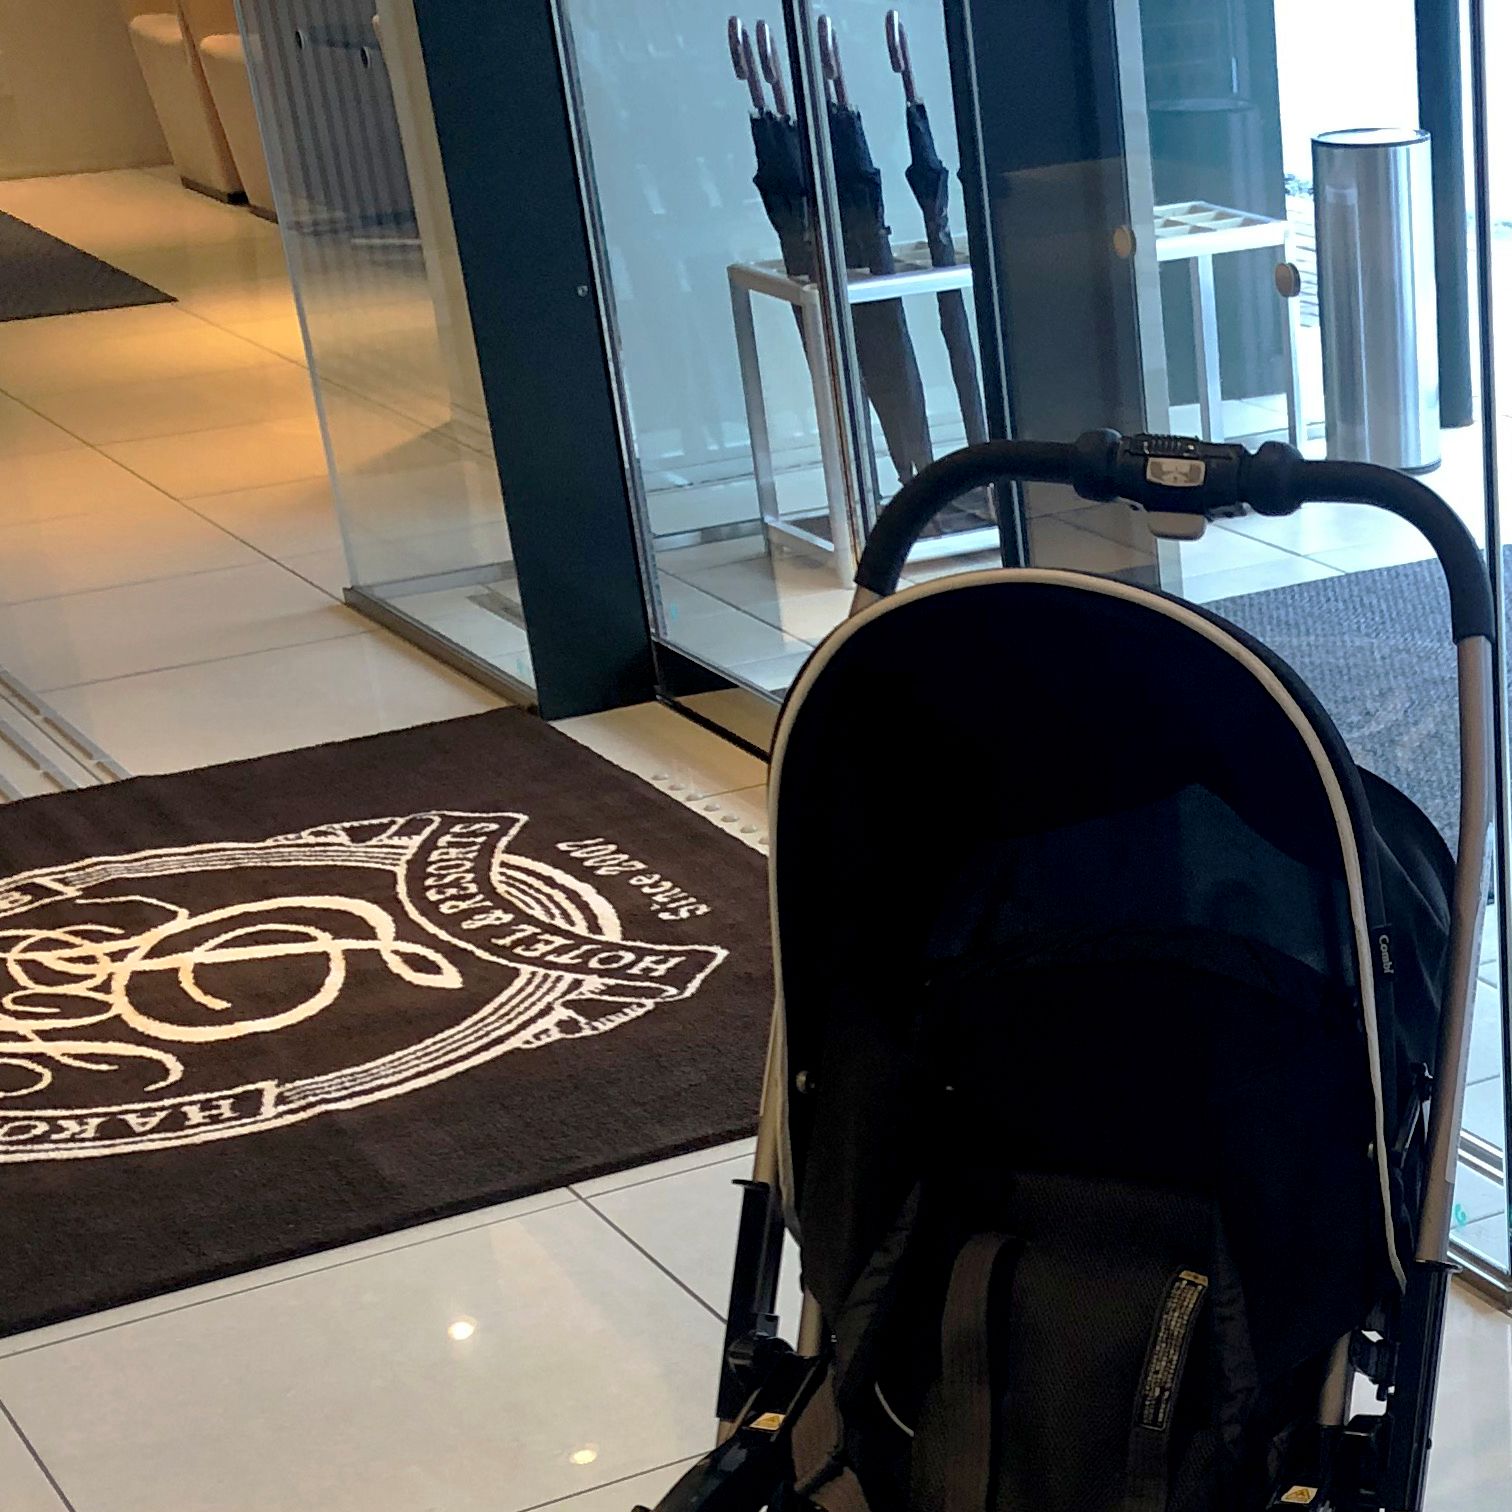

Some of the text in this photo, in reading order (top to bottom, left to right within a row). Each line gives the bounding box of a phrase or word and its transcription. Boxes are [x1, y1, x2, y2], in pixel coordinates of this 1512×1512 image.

[424, 822, 686, 977] HOTEL & RESORTS
[555, 838, 711, 921] Since 2007
[1378, 934, 1395, 974] Combi
